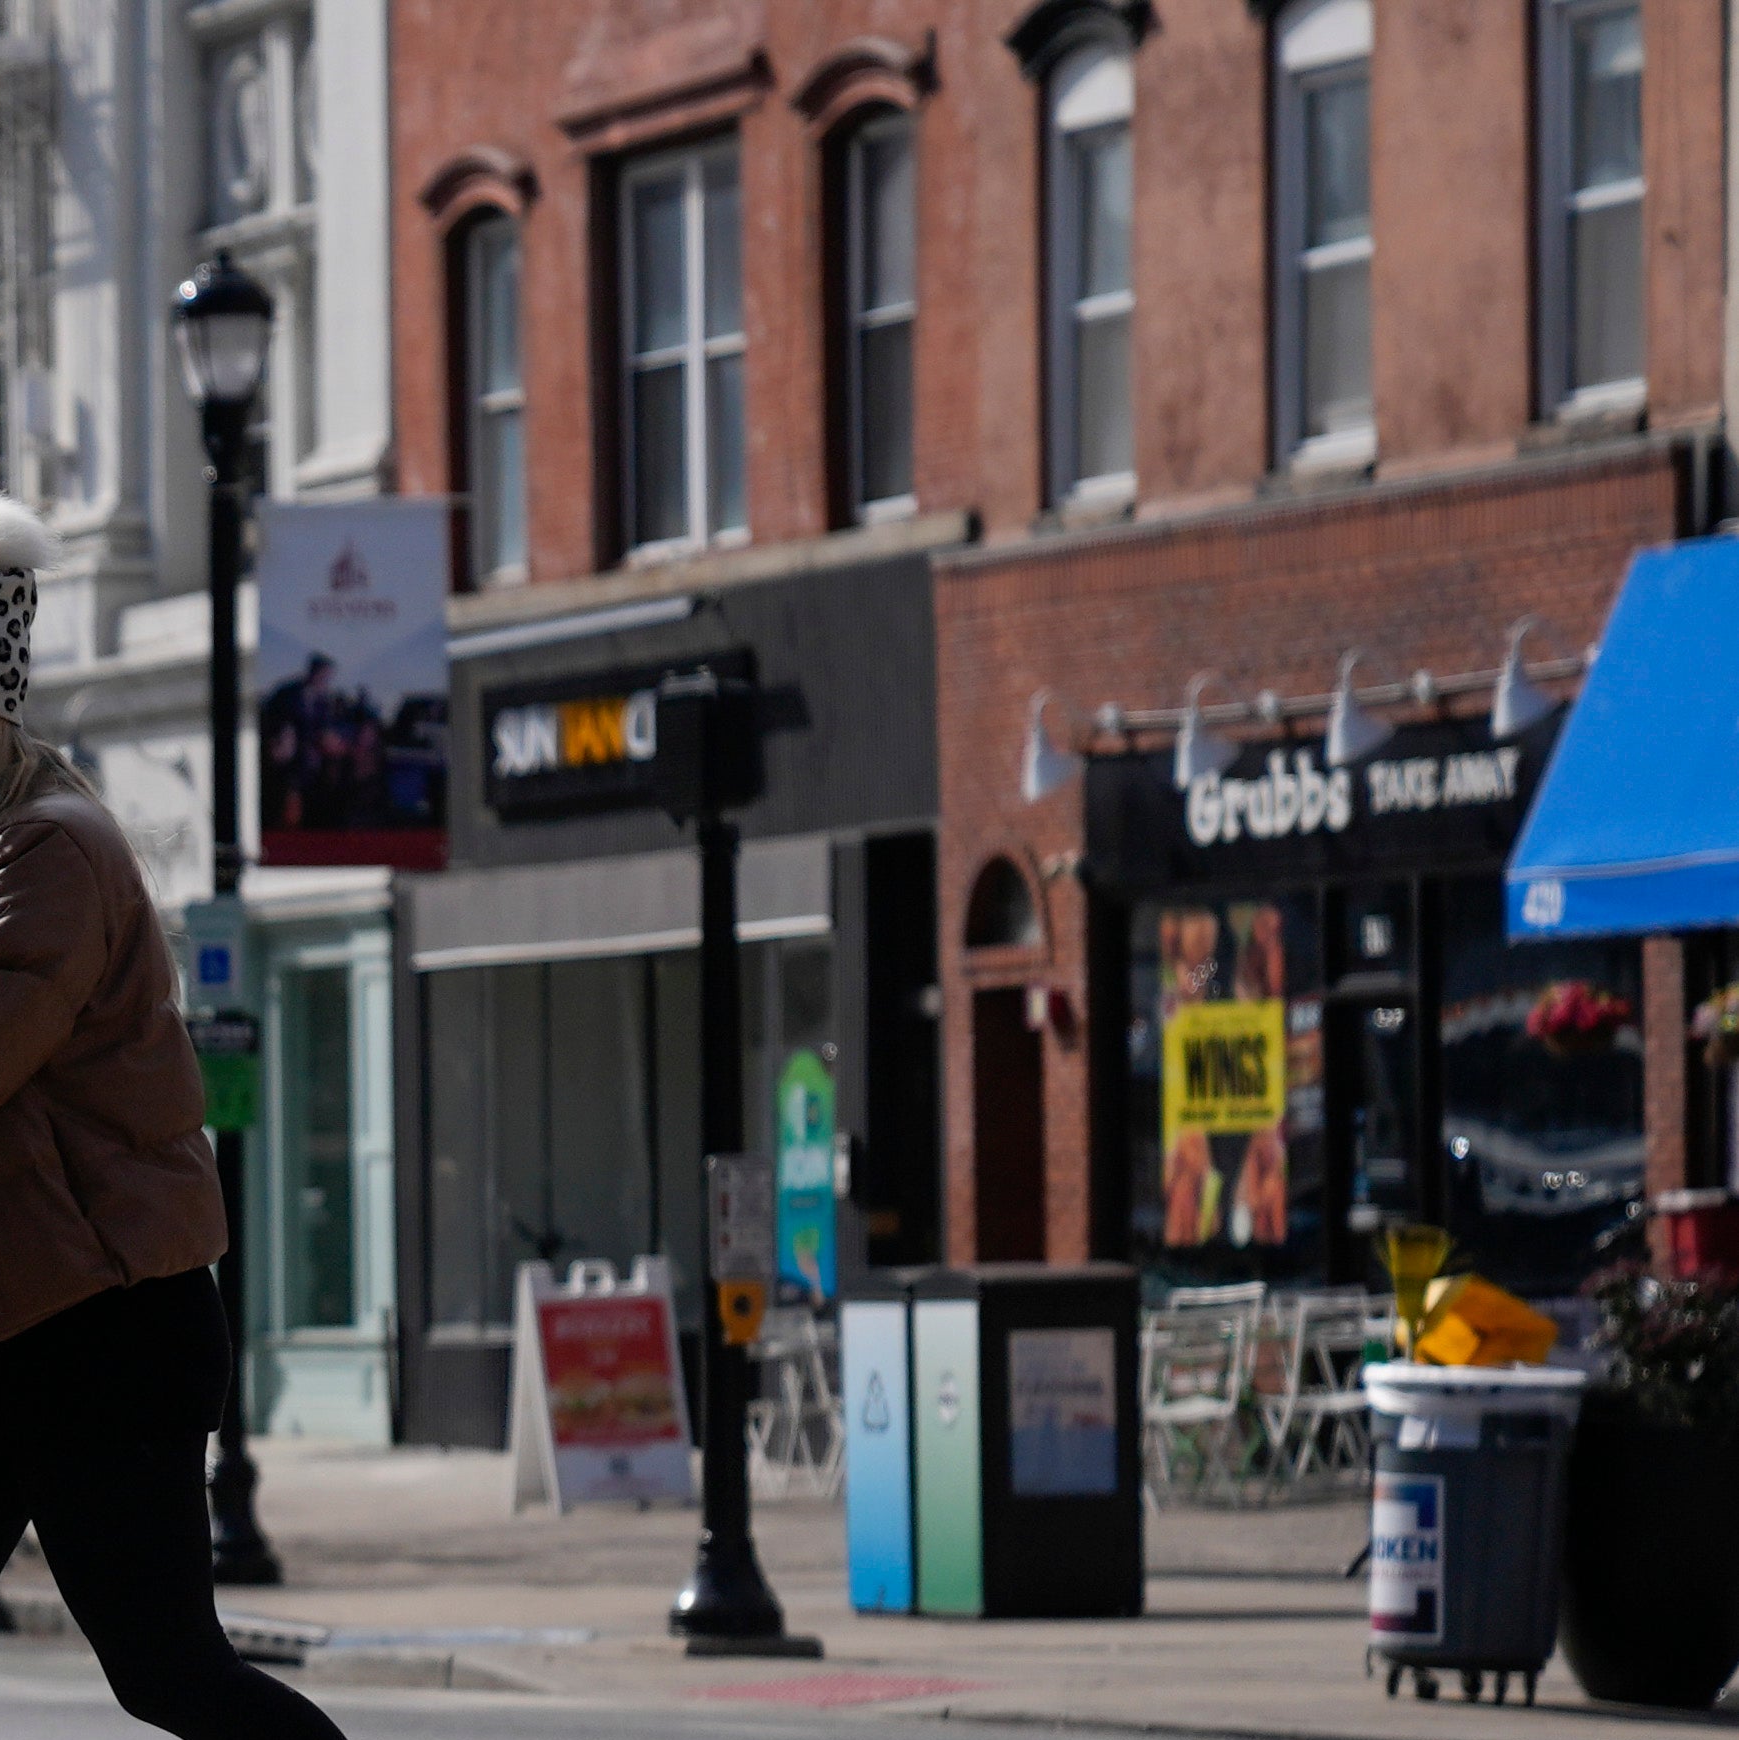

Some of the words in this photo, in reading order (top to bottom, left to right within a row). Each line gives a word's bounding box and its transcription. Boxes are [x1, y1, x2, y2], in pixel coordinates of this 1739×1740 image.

[1186, 748, 1353, 848] Grubbs
[1365, 757, 1438, 815] TAKE
[1182, 1032, 1269, 1103] WINGS
